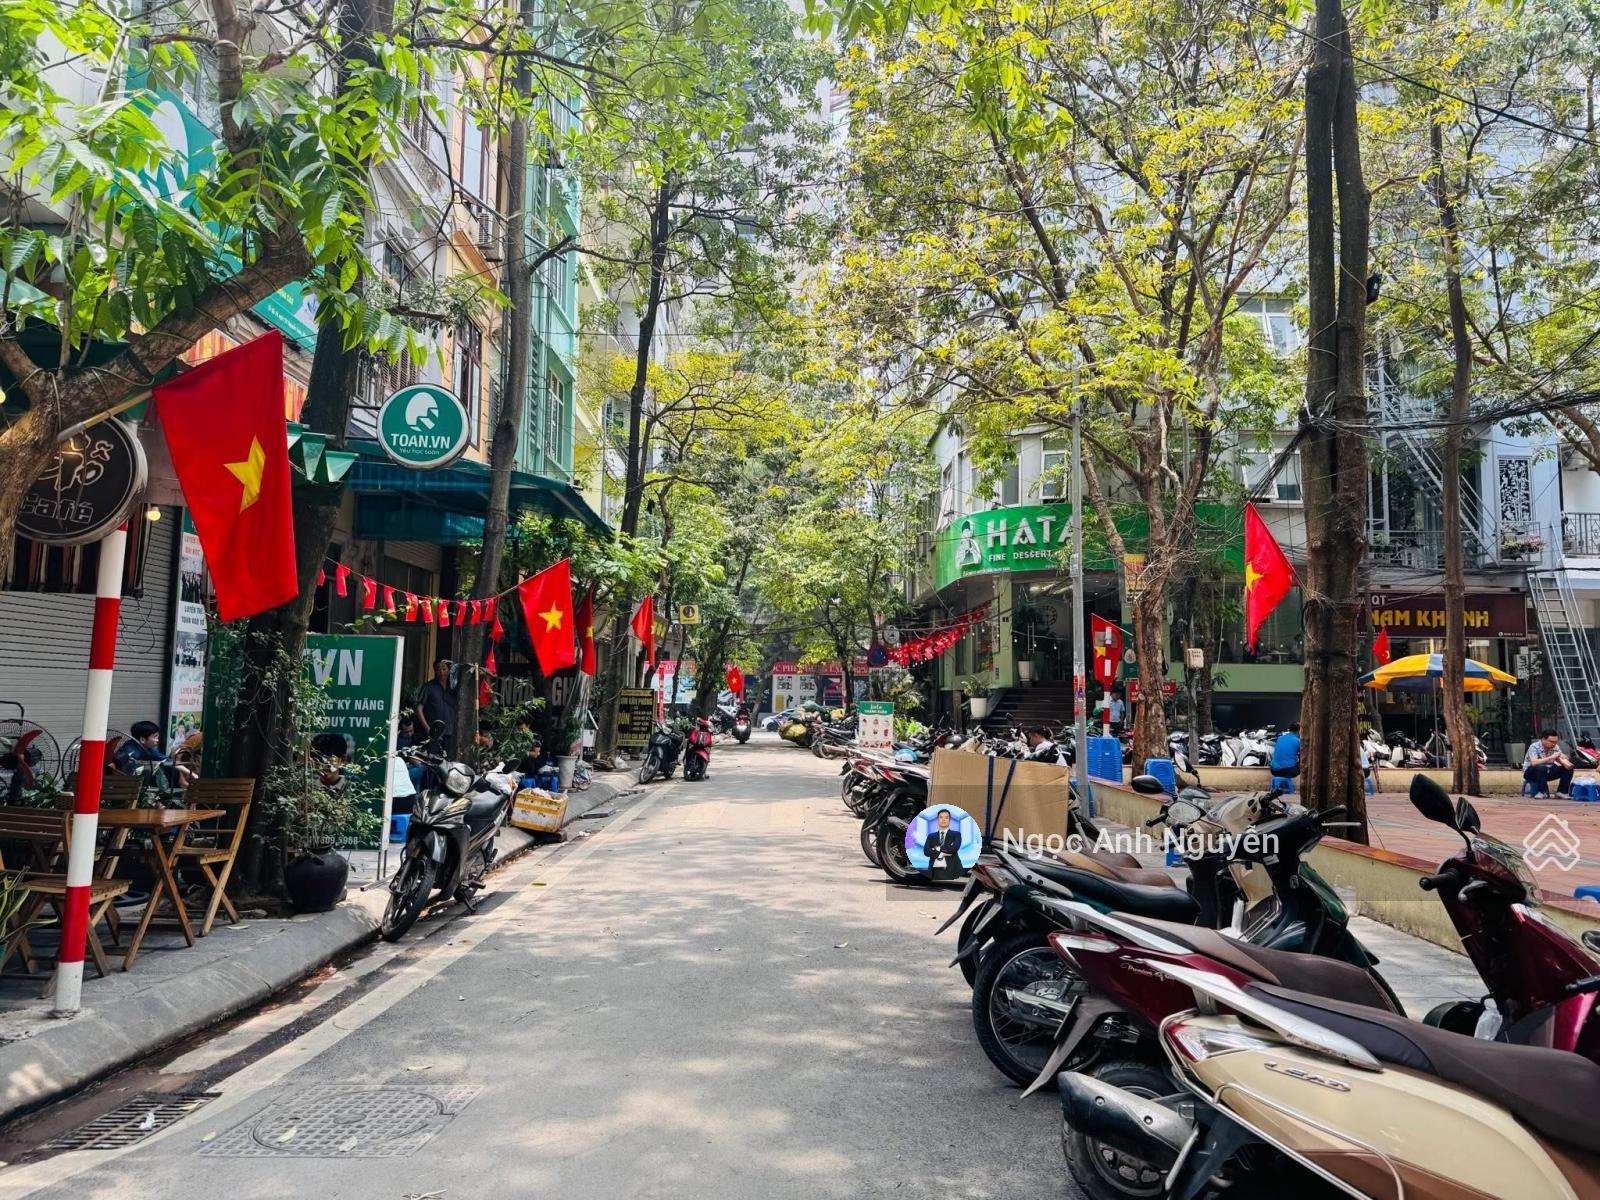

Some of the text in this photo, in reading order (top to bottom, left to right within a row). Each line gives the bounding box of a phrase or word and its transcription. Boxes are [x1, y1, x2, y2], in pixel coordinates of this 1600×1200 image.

[391, 433, 451, 449] TOAN.VN
[988, 550, 1052, 562] FINE DESSERT
[1371, 594, 1387, 606] QT
[1371, 609, 1489, 629] NAM KHNH
[354, 697, 385, 711] NĂNG
[349, 717, 370, 728] TVN
